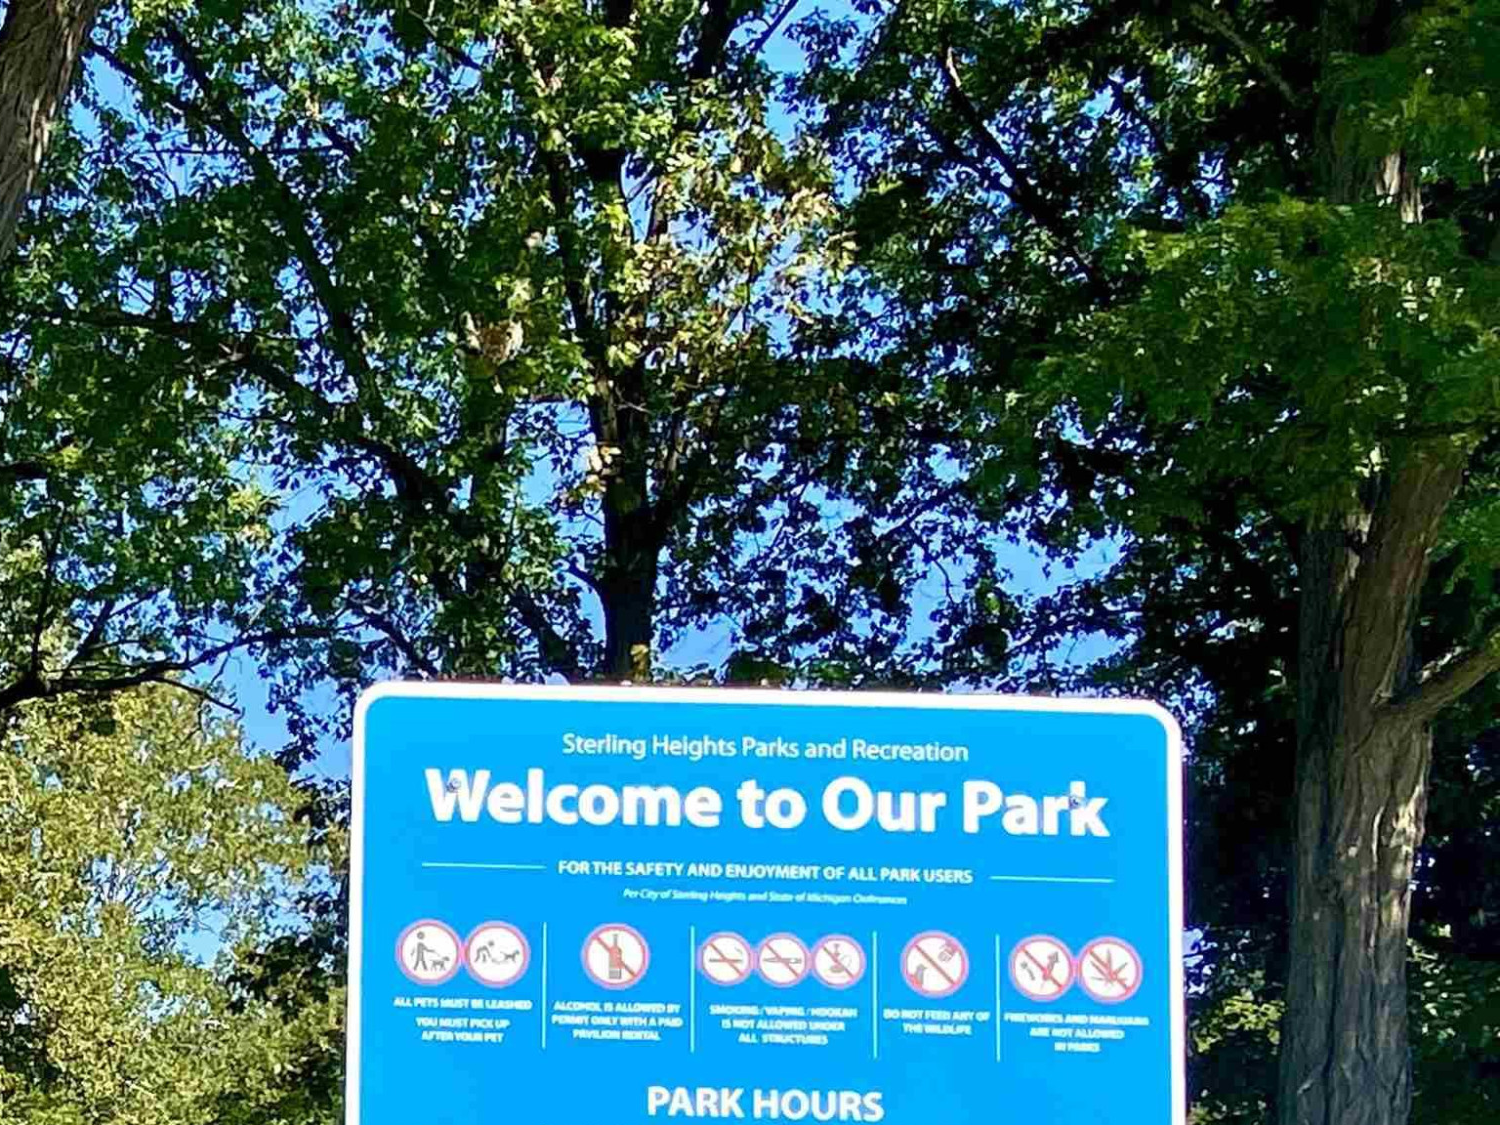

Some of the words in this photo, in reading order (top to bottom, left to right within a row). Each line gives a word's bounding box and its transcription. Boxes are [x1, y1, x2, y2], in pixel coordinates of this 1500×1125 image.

[563, 733, 646, 760] Sterling
[652, 735, 737, 761] Heights
[742, 736, 799, 757] Parks
[805, 738, 846, 758] and
[852, 739, 968, 761] Recreation
[425, 767, 723, 827] Welcome
[736, 779, 807, 828] to
[822, 776, 946, 832] Our
[963, 780, 1110, 837] Park
[558, 861, 591, 874] FOR
[591, 861, 622, 875] THE
[625, 862, 683, 876] SAFETY
[687, 863, 723, 877] AND
[725, 863, 821, 879] ENJOYMENT
[823, 866, 844, 880] OF
[848, 867, 877, 881] ALL
[880, 867, 920, 882] PARK
[923, 869, 973, 883] USERS
[614, 1003, 666, 1013] ALLOWED
[900, 1009, 923, 1019] NOT
[756, 1019, 808, 1031] ALLOWED
[648, 1086, 744, 1118] PARK
[753, 1089, 884, 1122] HOURS
